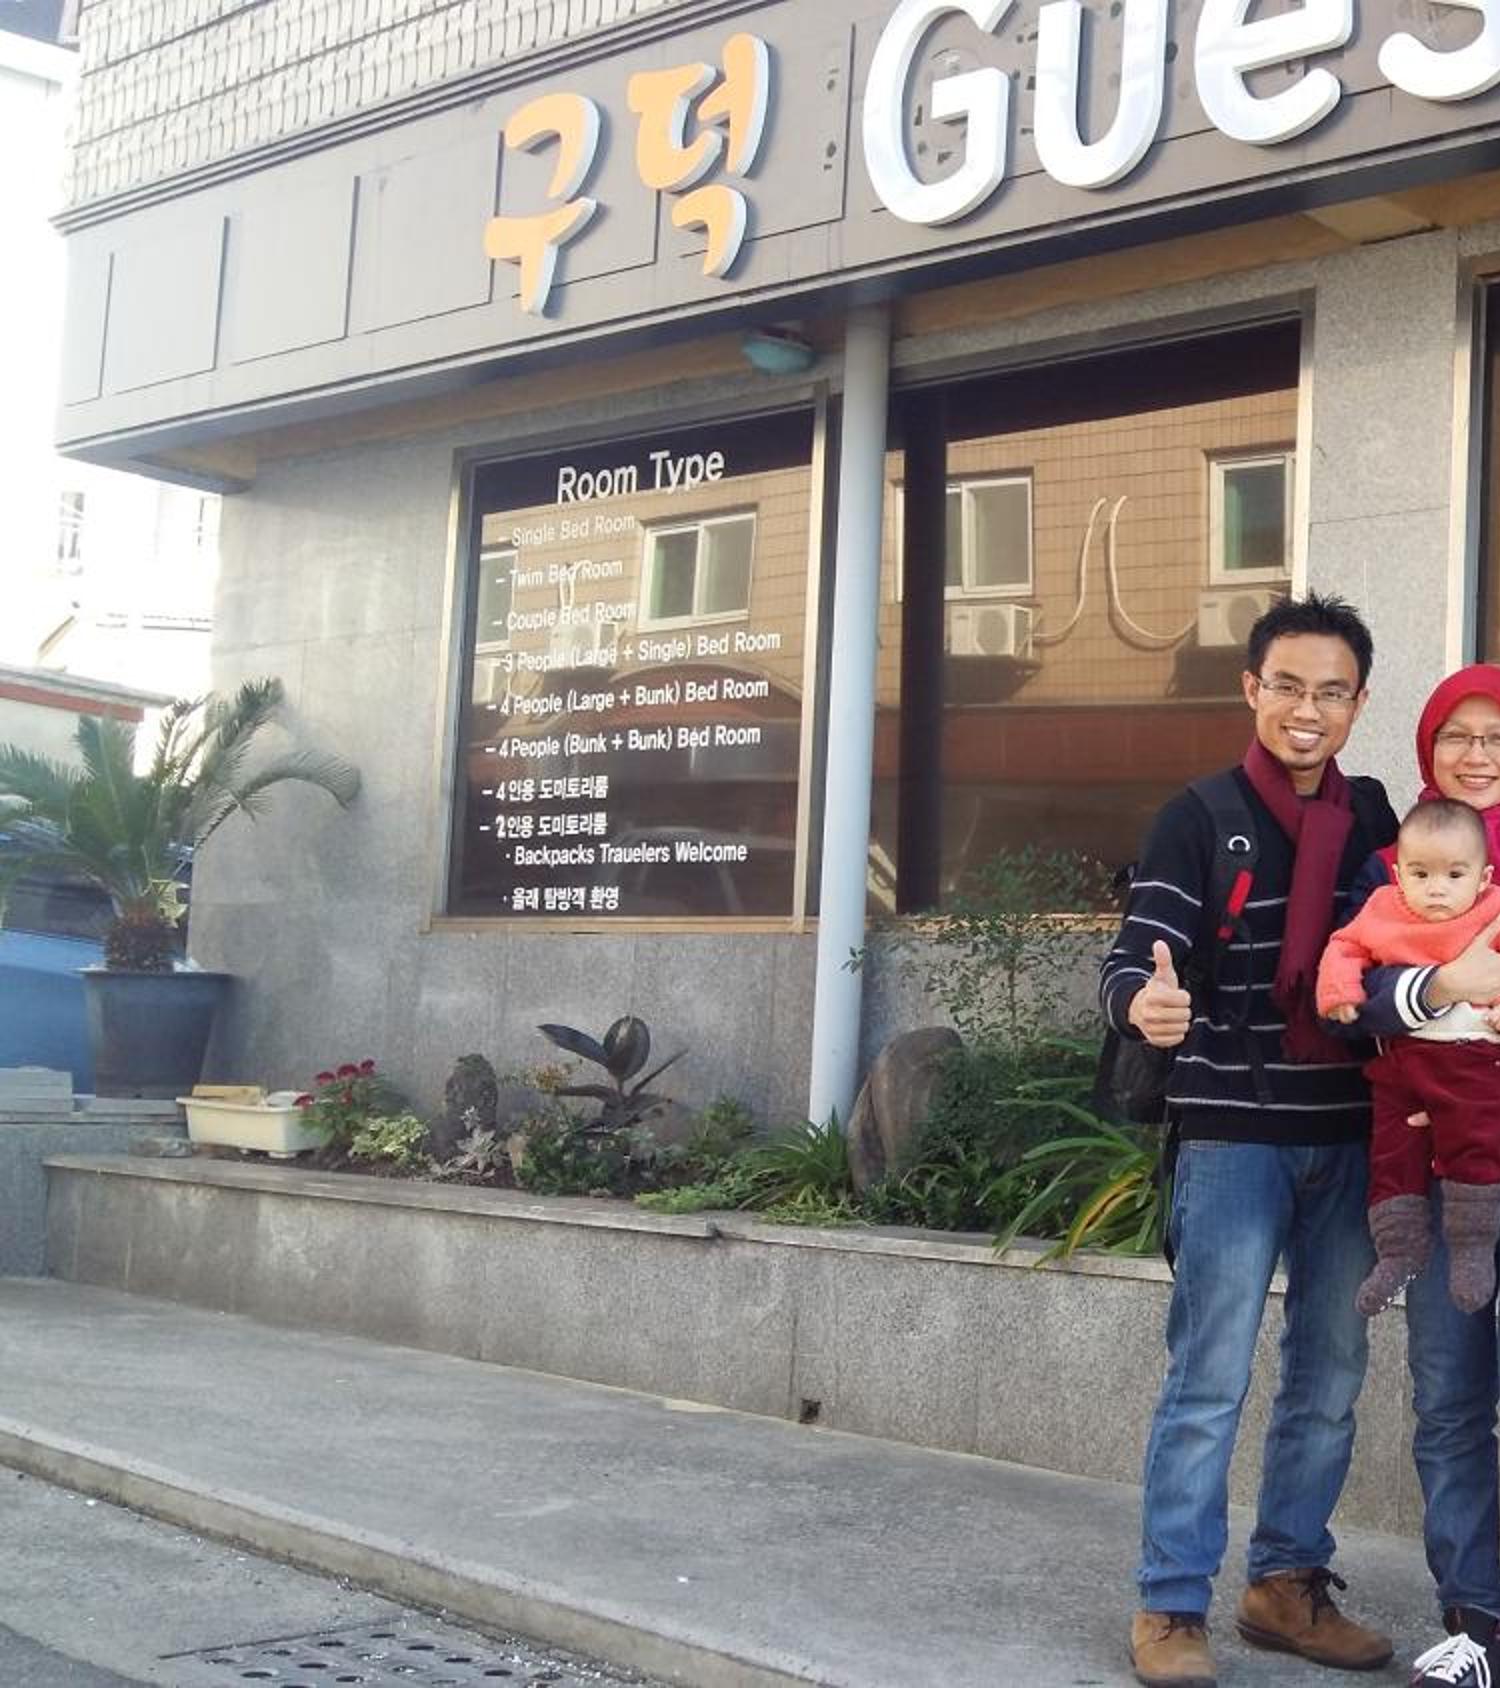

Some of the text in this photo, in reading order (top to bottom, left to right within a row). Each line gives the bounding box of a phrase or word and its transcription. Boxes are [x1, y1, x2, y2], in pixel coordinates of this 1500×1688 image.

[557, 450, 725, 504] Room Type
[512, 515, 635, 547] Single Bed Room
[549, 562, 577, 583] Bed
[582, 560, 623, 578] Room
[507, 602, 637, 631] Couple Bed Room
[517, 649, 566, 673] People
[637, 637, 692, 661] Single)
[697, 634, 729, 657] Bed
[735, 630, 781, 652] Room
[512, 693, 563, 717] People
[567, 689, 615, 714] (Large
[619, 691, 632, 705] +
[635, 680, 681, 705] Bunk)
[685, 680, 719, 703] Bed
[722, 678, 769, 700] Room
[511, 734, 561, 759] People
[564, 732, 607, 757] (Bunk
[611, 736, 623, 750] +
[628, 727, 673, 751] Bunk)
[677, 726, 709, 749] Bed
[715, 725, 761, 745] Room
[514, 842, 595, 868] Backpacks
[675, 840, 748, 863] Welcome
[590, 886, 620, 911] 환영
